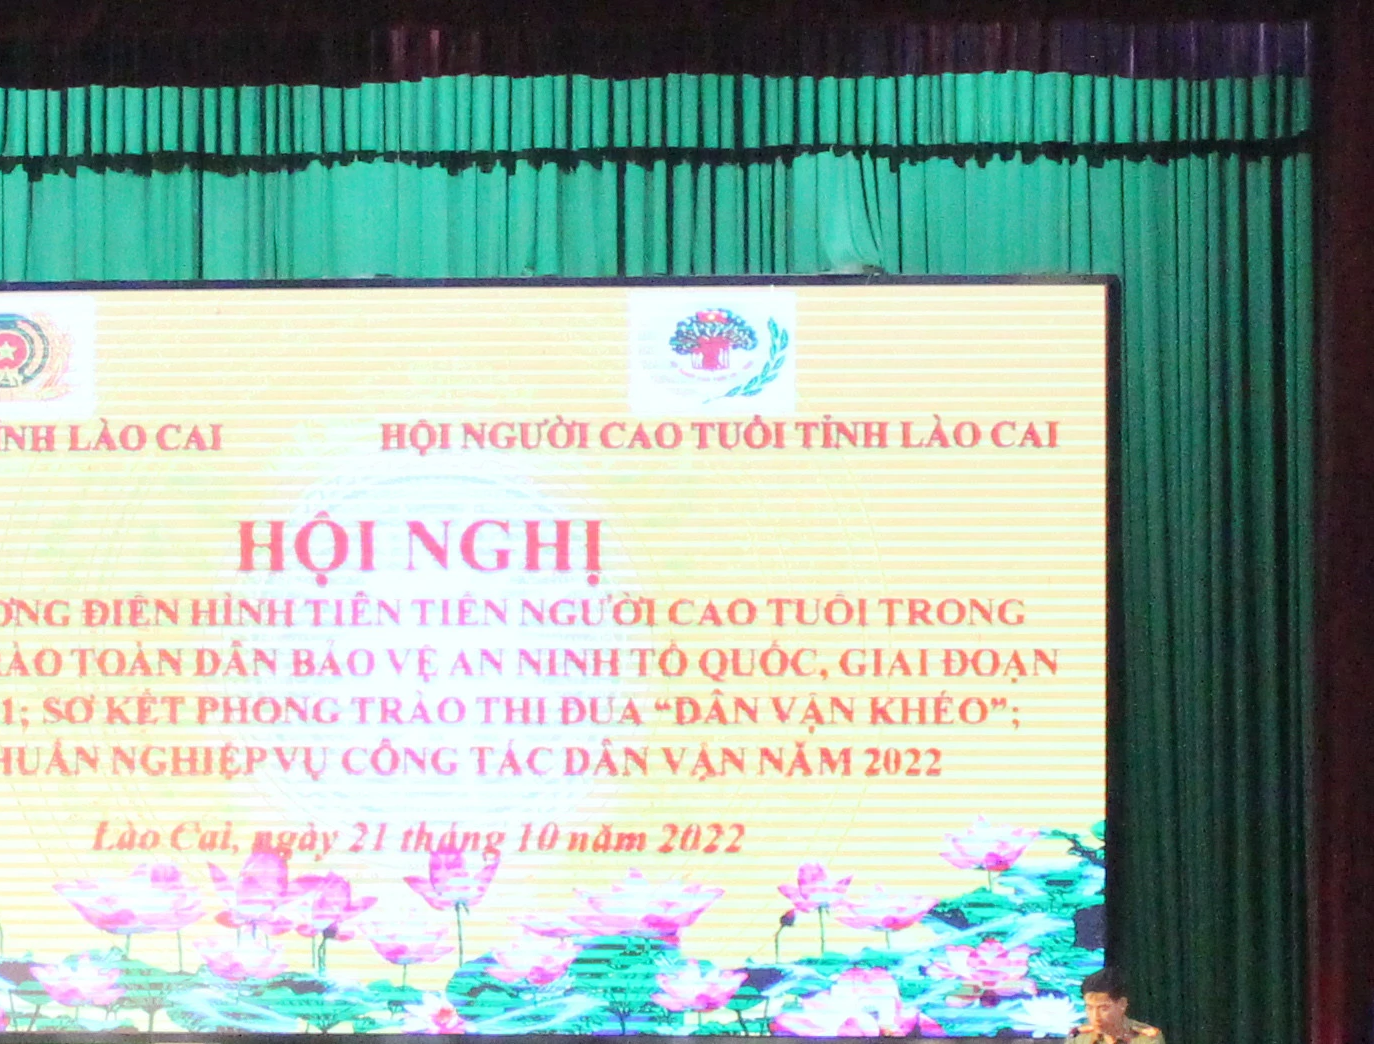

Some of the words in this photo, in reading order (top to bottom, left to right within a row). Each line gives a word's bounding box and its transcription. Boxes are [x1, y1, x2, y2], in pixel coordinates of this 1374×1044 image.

[68, 418, 147, 452] LÀO
[156, 424, 223, 451] CAI
[381, 419, 452, 456] HỘI
[462, 415, 590, 450] NGƯỜI
[599, 422, 683, 449] CAO
[691, 414, 786, 449] TUỔI
[794, 414, 889, 449] TỈNH
[899, 414, 982, 448] LÀO
[990, 421, 1060, 448] CAI
[238, 510, 377, 587] HỘI
[406, 519, 602, 587] NGHỊ
[191, 592, 295, 627] HÌNH
[304, 590, 402, 627] TIÊN
[520, 591, 656, 626] NGƯỜI
[668, 599, 759, 626] CAO
[877, 598, 1026, 626] TRONG
[71, 641, 182, 676] TOÀN
[193, 639, 278, 676] DÂN
[290, 639, 375, 677] BẢO
[387, 644, 439, 682] VỆ
[449, 650, 503, 676] AN
[518, 648, 620, 677] NINH
[698, 639, 829, 683] QUỐC,
[839, 648, 929, 677] GIAI
[940, 648, 1059, 683] ĐOẠN
[42, 694, 95, 725] SƠ
[106, 688, 185, 725] KẾT
[196, 696, 340, 724] PHONG
[351, 690, 467, 725] TRÀO
[476, 697, 547, 725] THI
[560, 697, 643, 725] ĐUA
[770, 692, 856, 734] VẬN
[112, 742, 268, 780] NGHIỆP
[273, 746, 328, 781] VỤ
[341, 737, 458, 776] CÔNG
[470, 739, 554, 776] TÁC
[563, 737, 649, 776] DÂN
[660, 741, 746, 782] VẬN
[757, 740, 853, 777] NĂM
[864, 747, 943, 777] 2022
[92, 820, 161, 852] Lào
[170, 821, 239, 854] Cai,
[251, 822, 339, 863] ngày
[348, 821, 388, 853] 21
[400, 820, 506, 862] tháng
[518, 822, 560, 853] 10
[567, 823, 648, 853] năm
[657, 823, 747, 854] 2022
